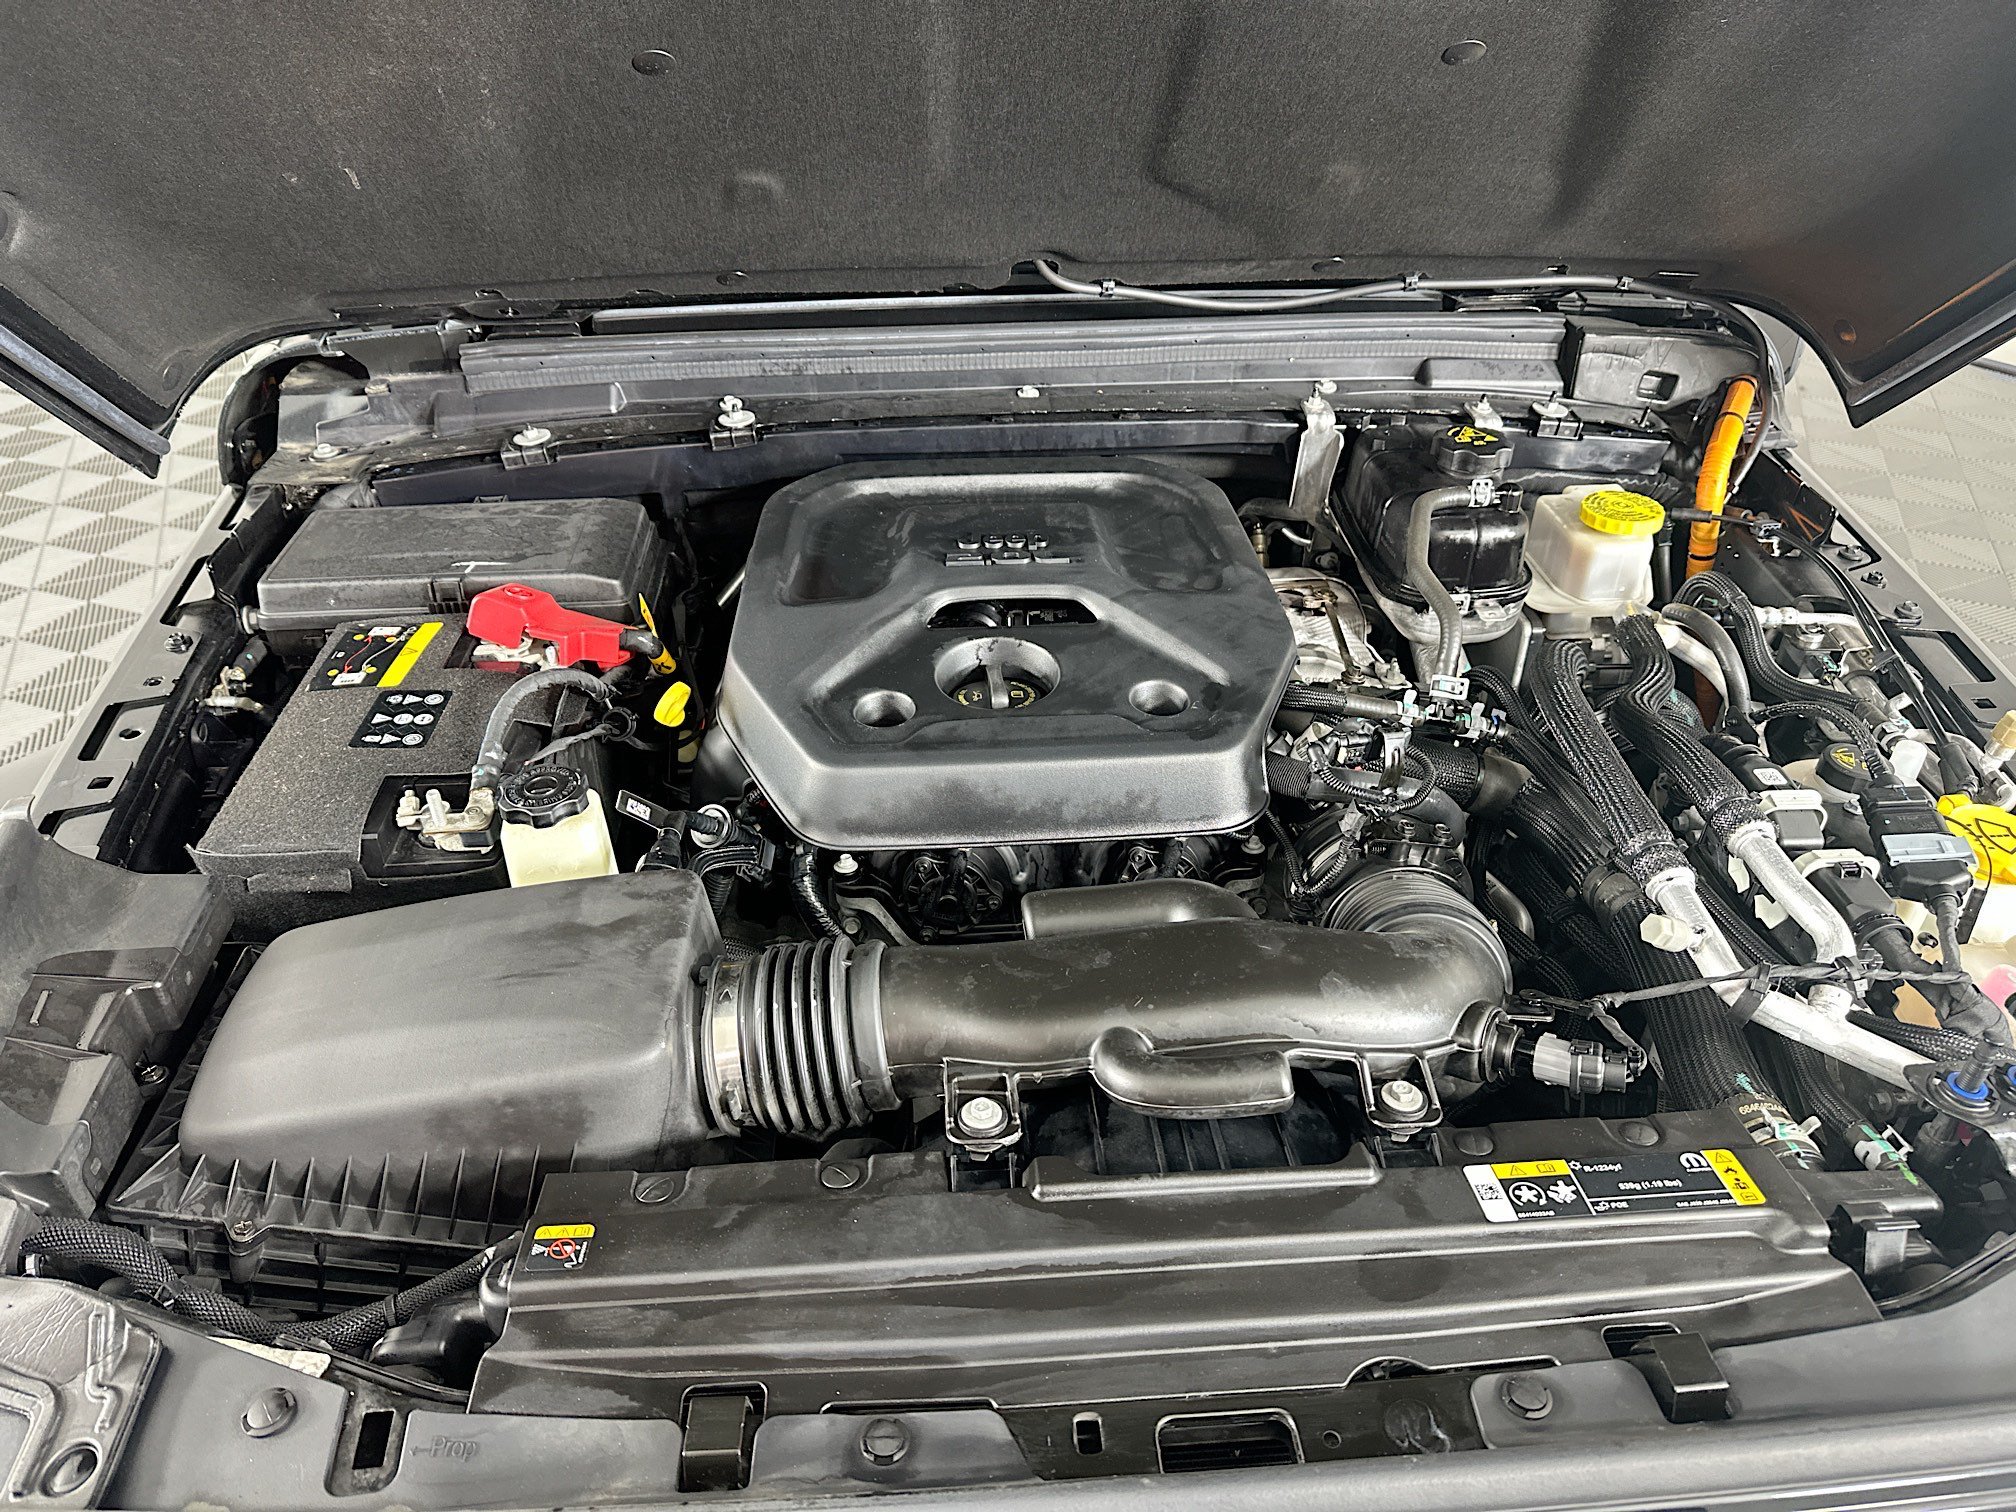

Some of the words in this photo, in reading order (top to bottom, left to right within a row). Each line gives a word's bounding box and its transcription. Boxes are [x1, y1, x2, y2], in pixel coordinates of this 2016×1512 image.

[945, 549, 1071, 567] 2.0L
[1663, 1178, 1683, 1188] lbs)
[1610, 1201, 1629, 1209] POE
[430, 1435, 477, 1462] Prop
